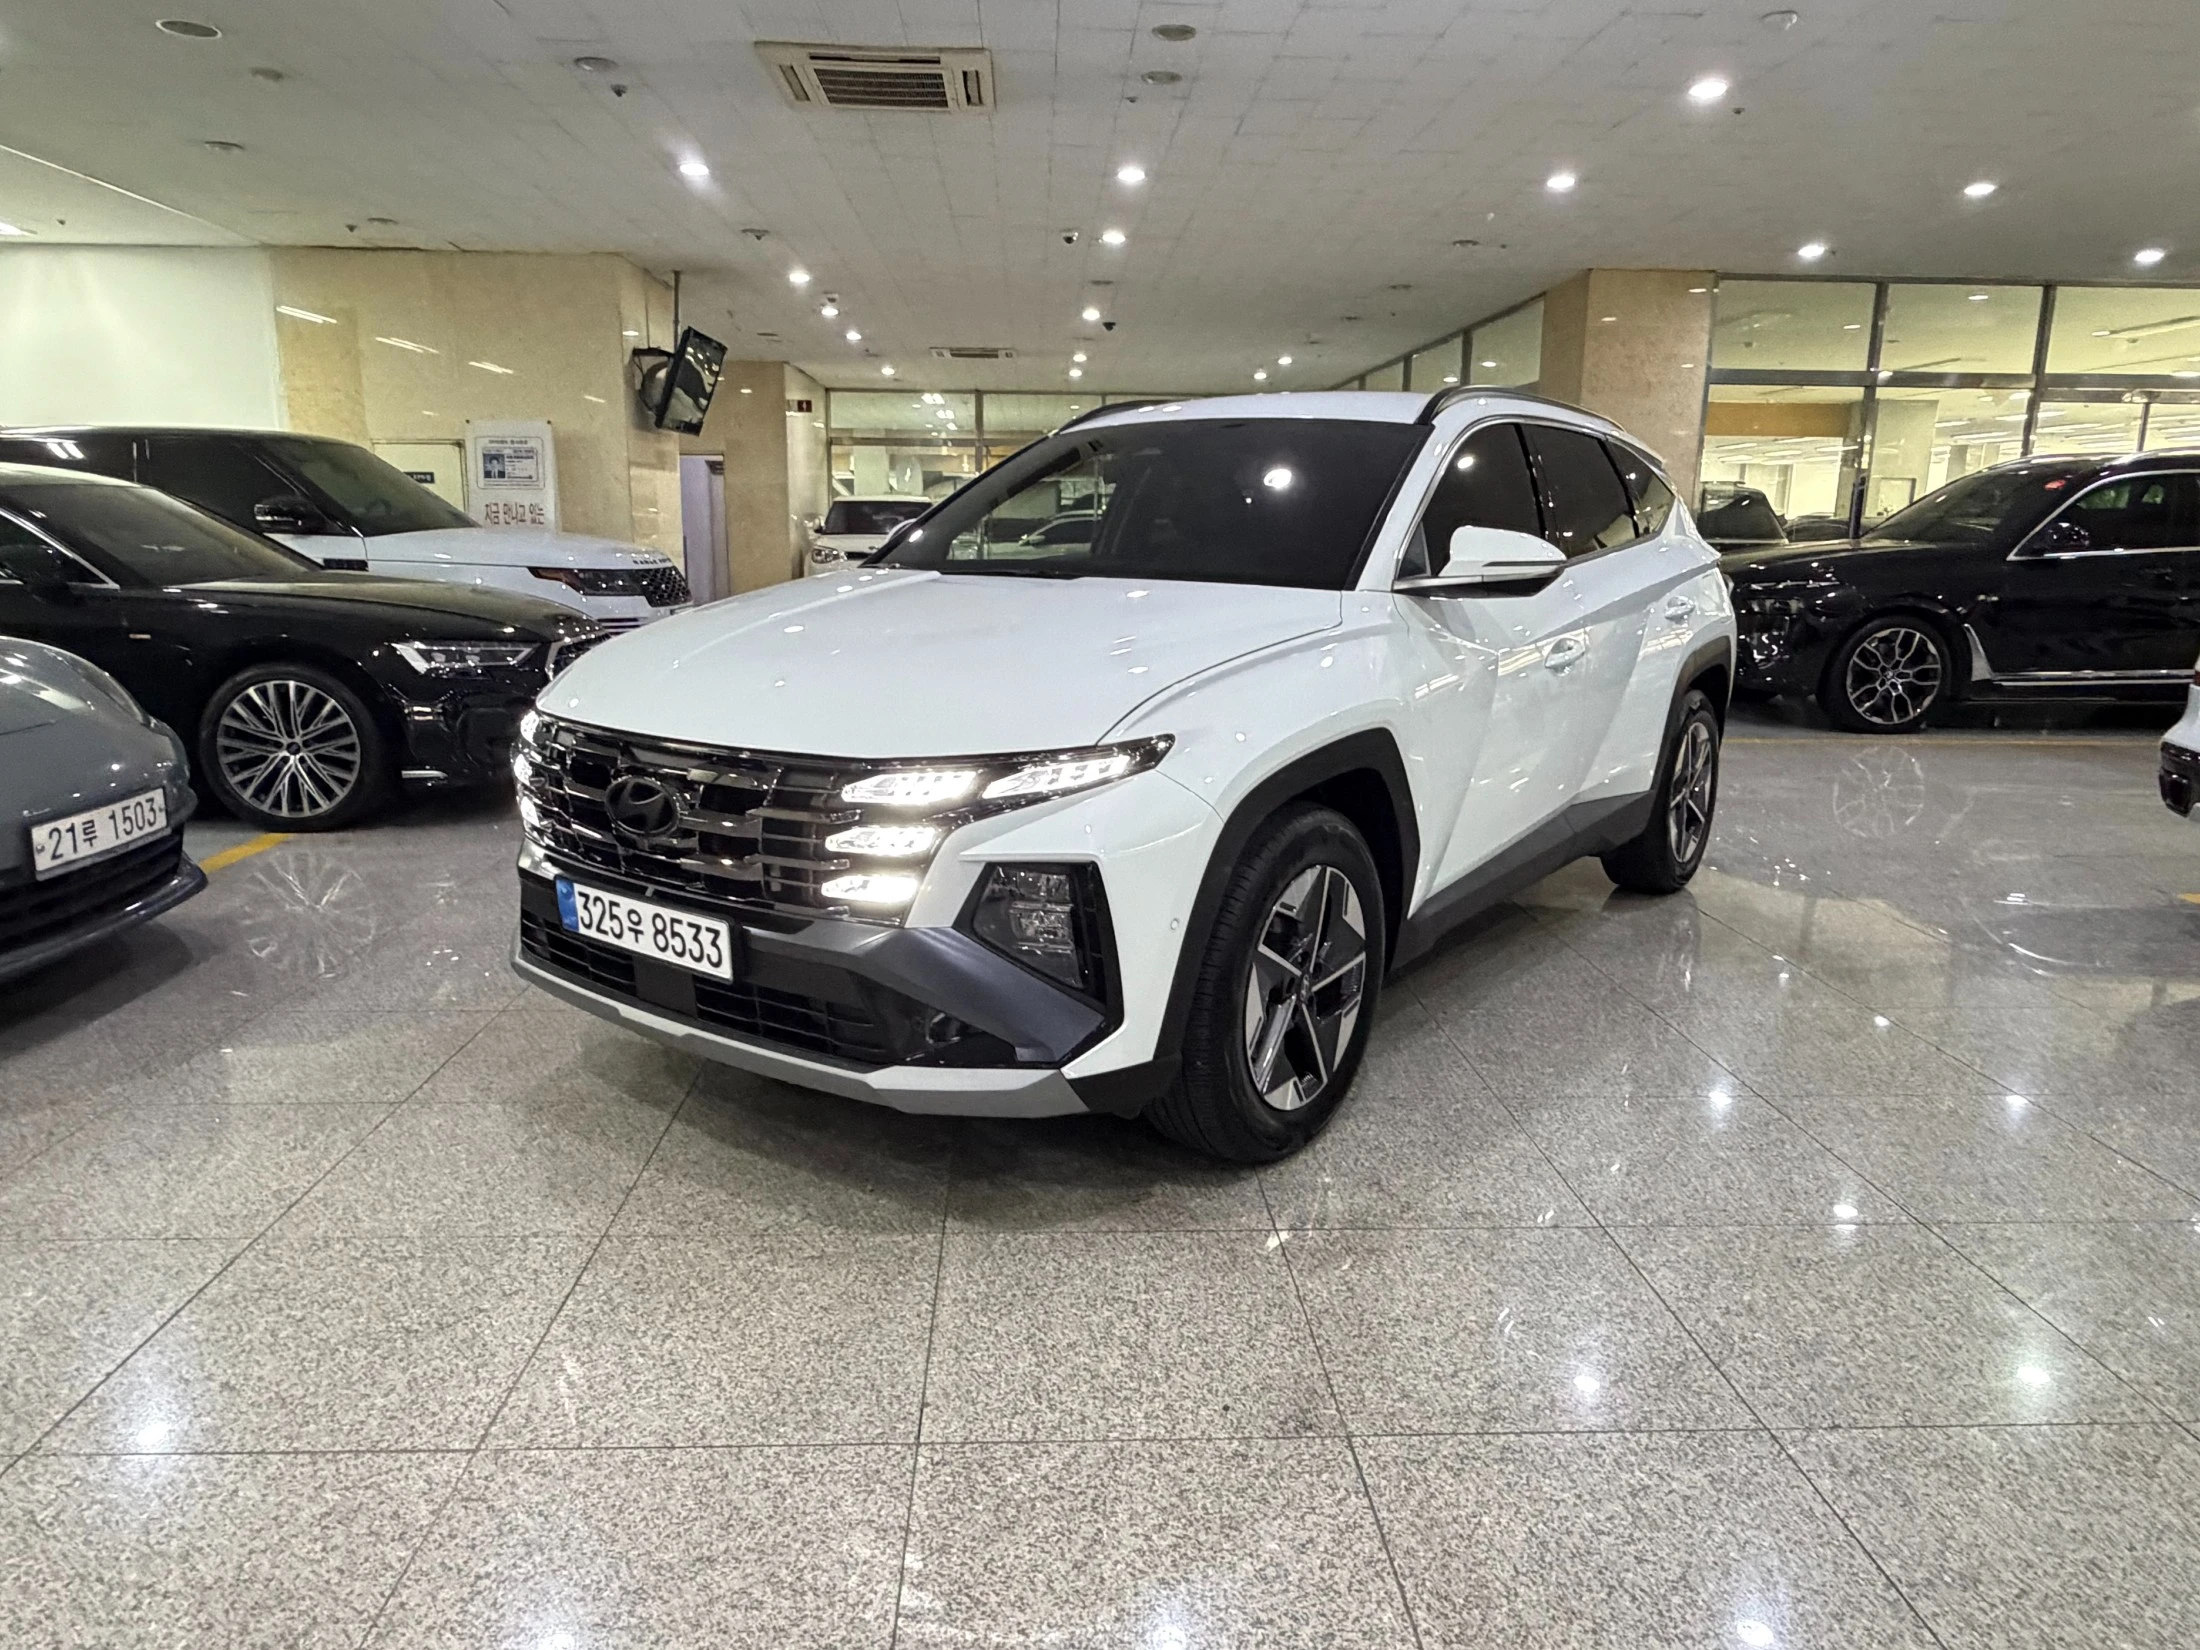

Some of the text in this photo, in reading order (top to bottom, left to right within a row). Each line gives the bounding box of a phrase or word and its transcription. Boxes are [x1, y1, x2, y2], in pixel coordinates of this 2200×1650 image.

[485, 502, 500, 525] 지금
[503, 502, 526, 525] 만나고
[48, 797, 157, 861] 21루 1503
[577, 890, 723, 969] 325우 8533
